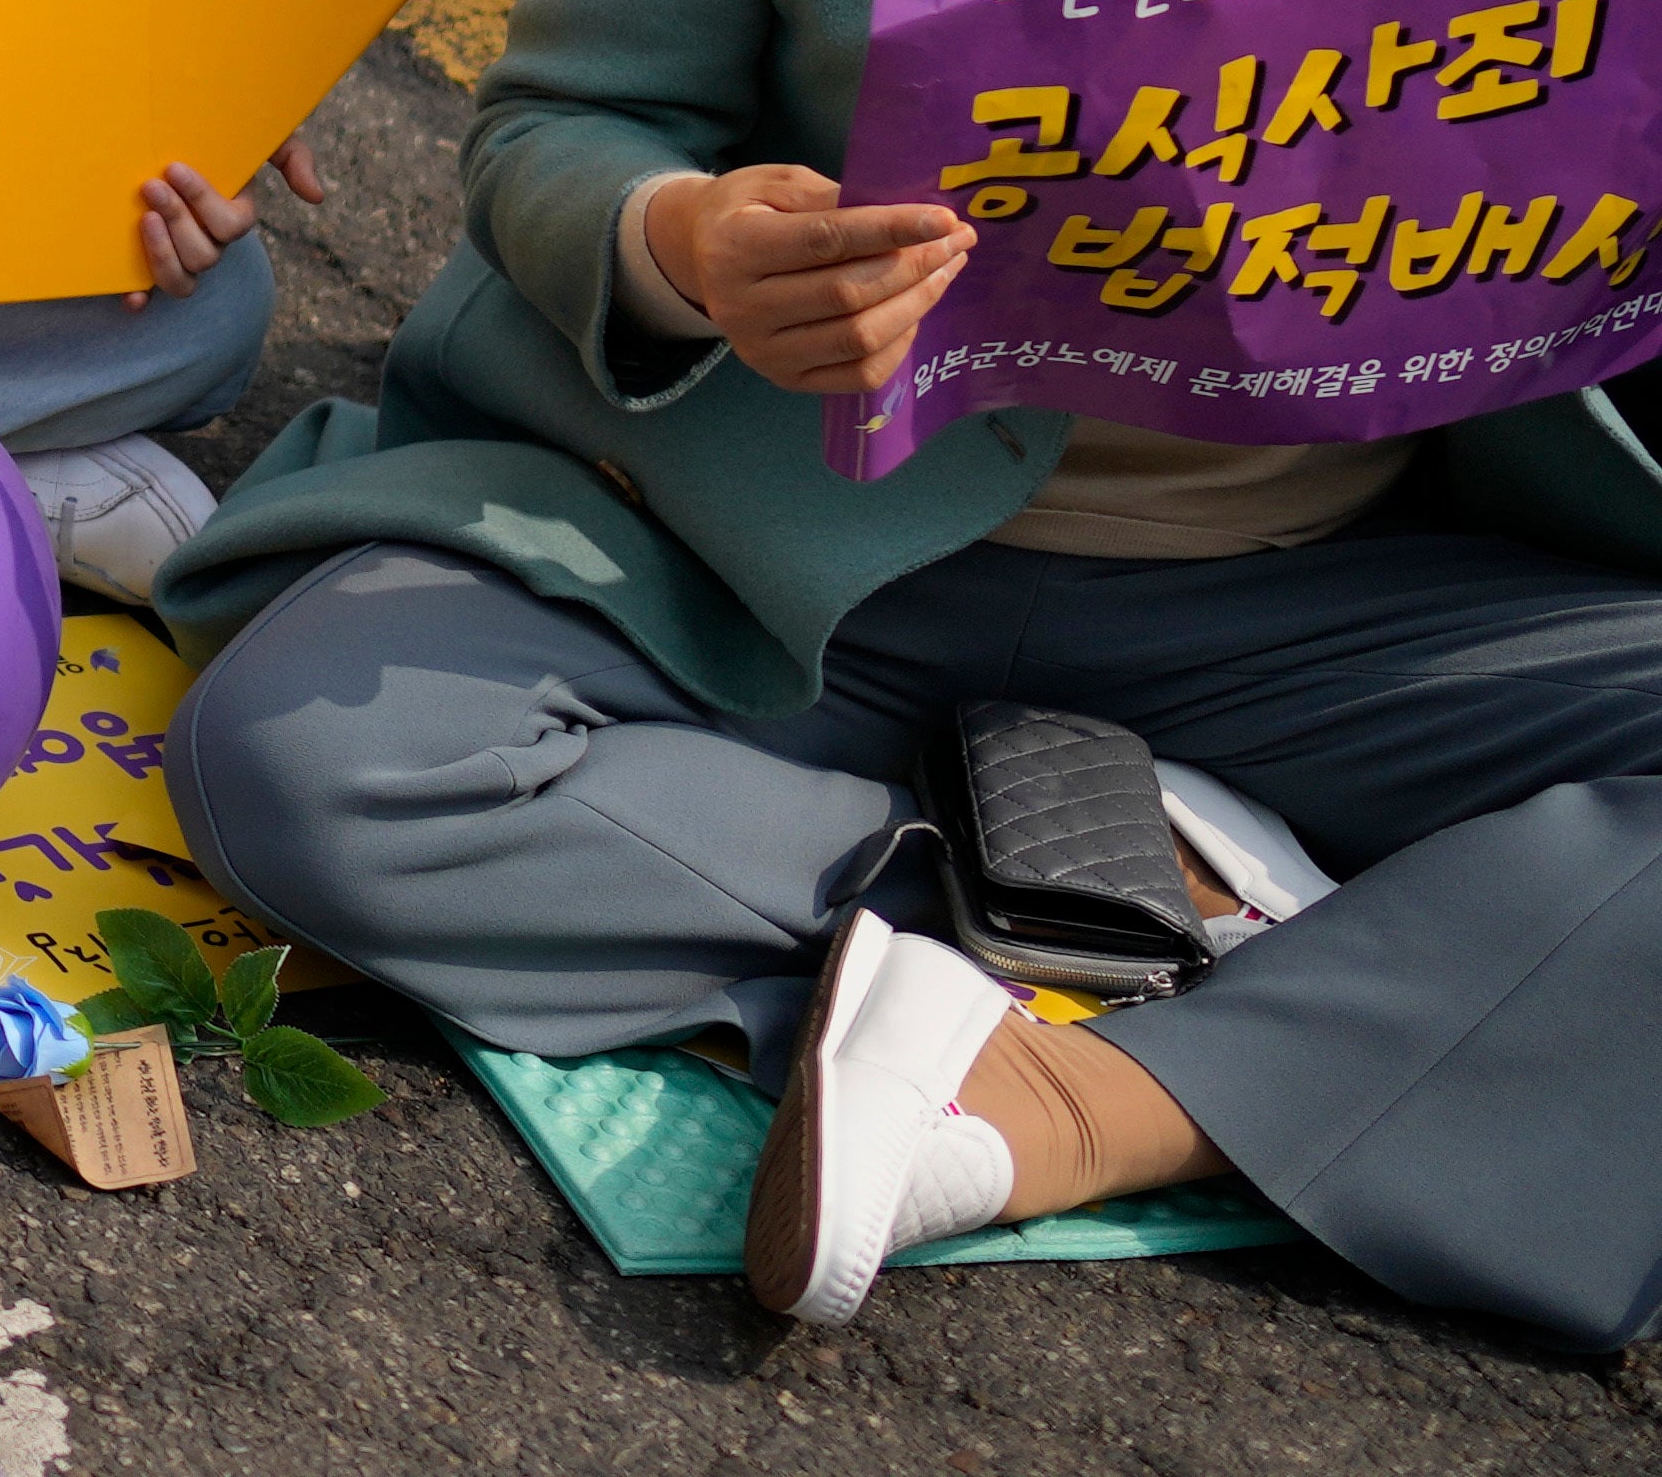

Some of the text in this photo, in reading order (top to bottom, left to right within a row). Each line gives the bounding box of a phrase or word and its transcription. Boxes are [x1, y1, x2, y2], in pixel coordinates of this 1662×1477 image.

[912, 338, 1178, 401] 일본군성노예제
[1187, 358, 1387, 399] 문제해결을
[1397, 346, 1475, 385] 위한
